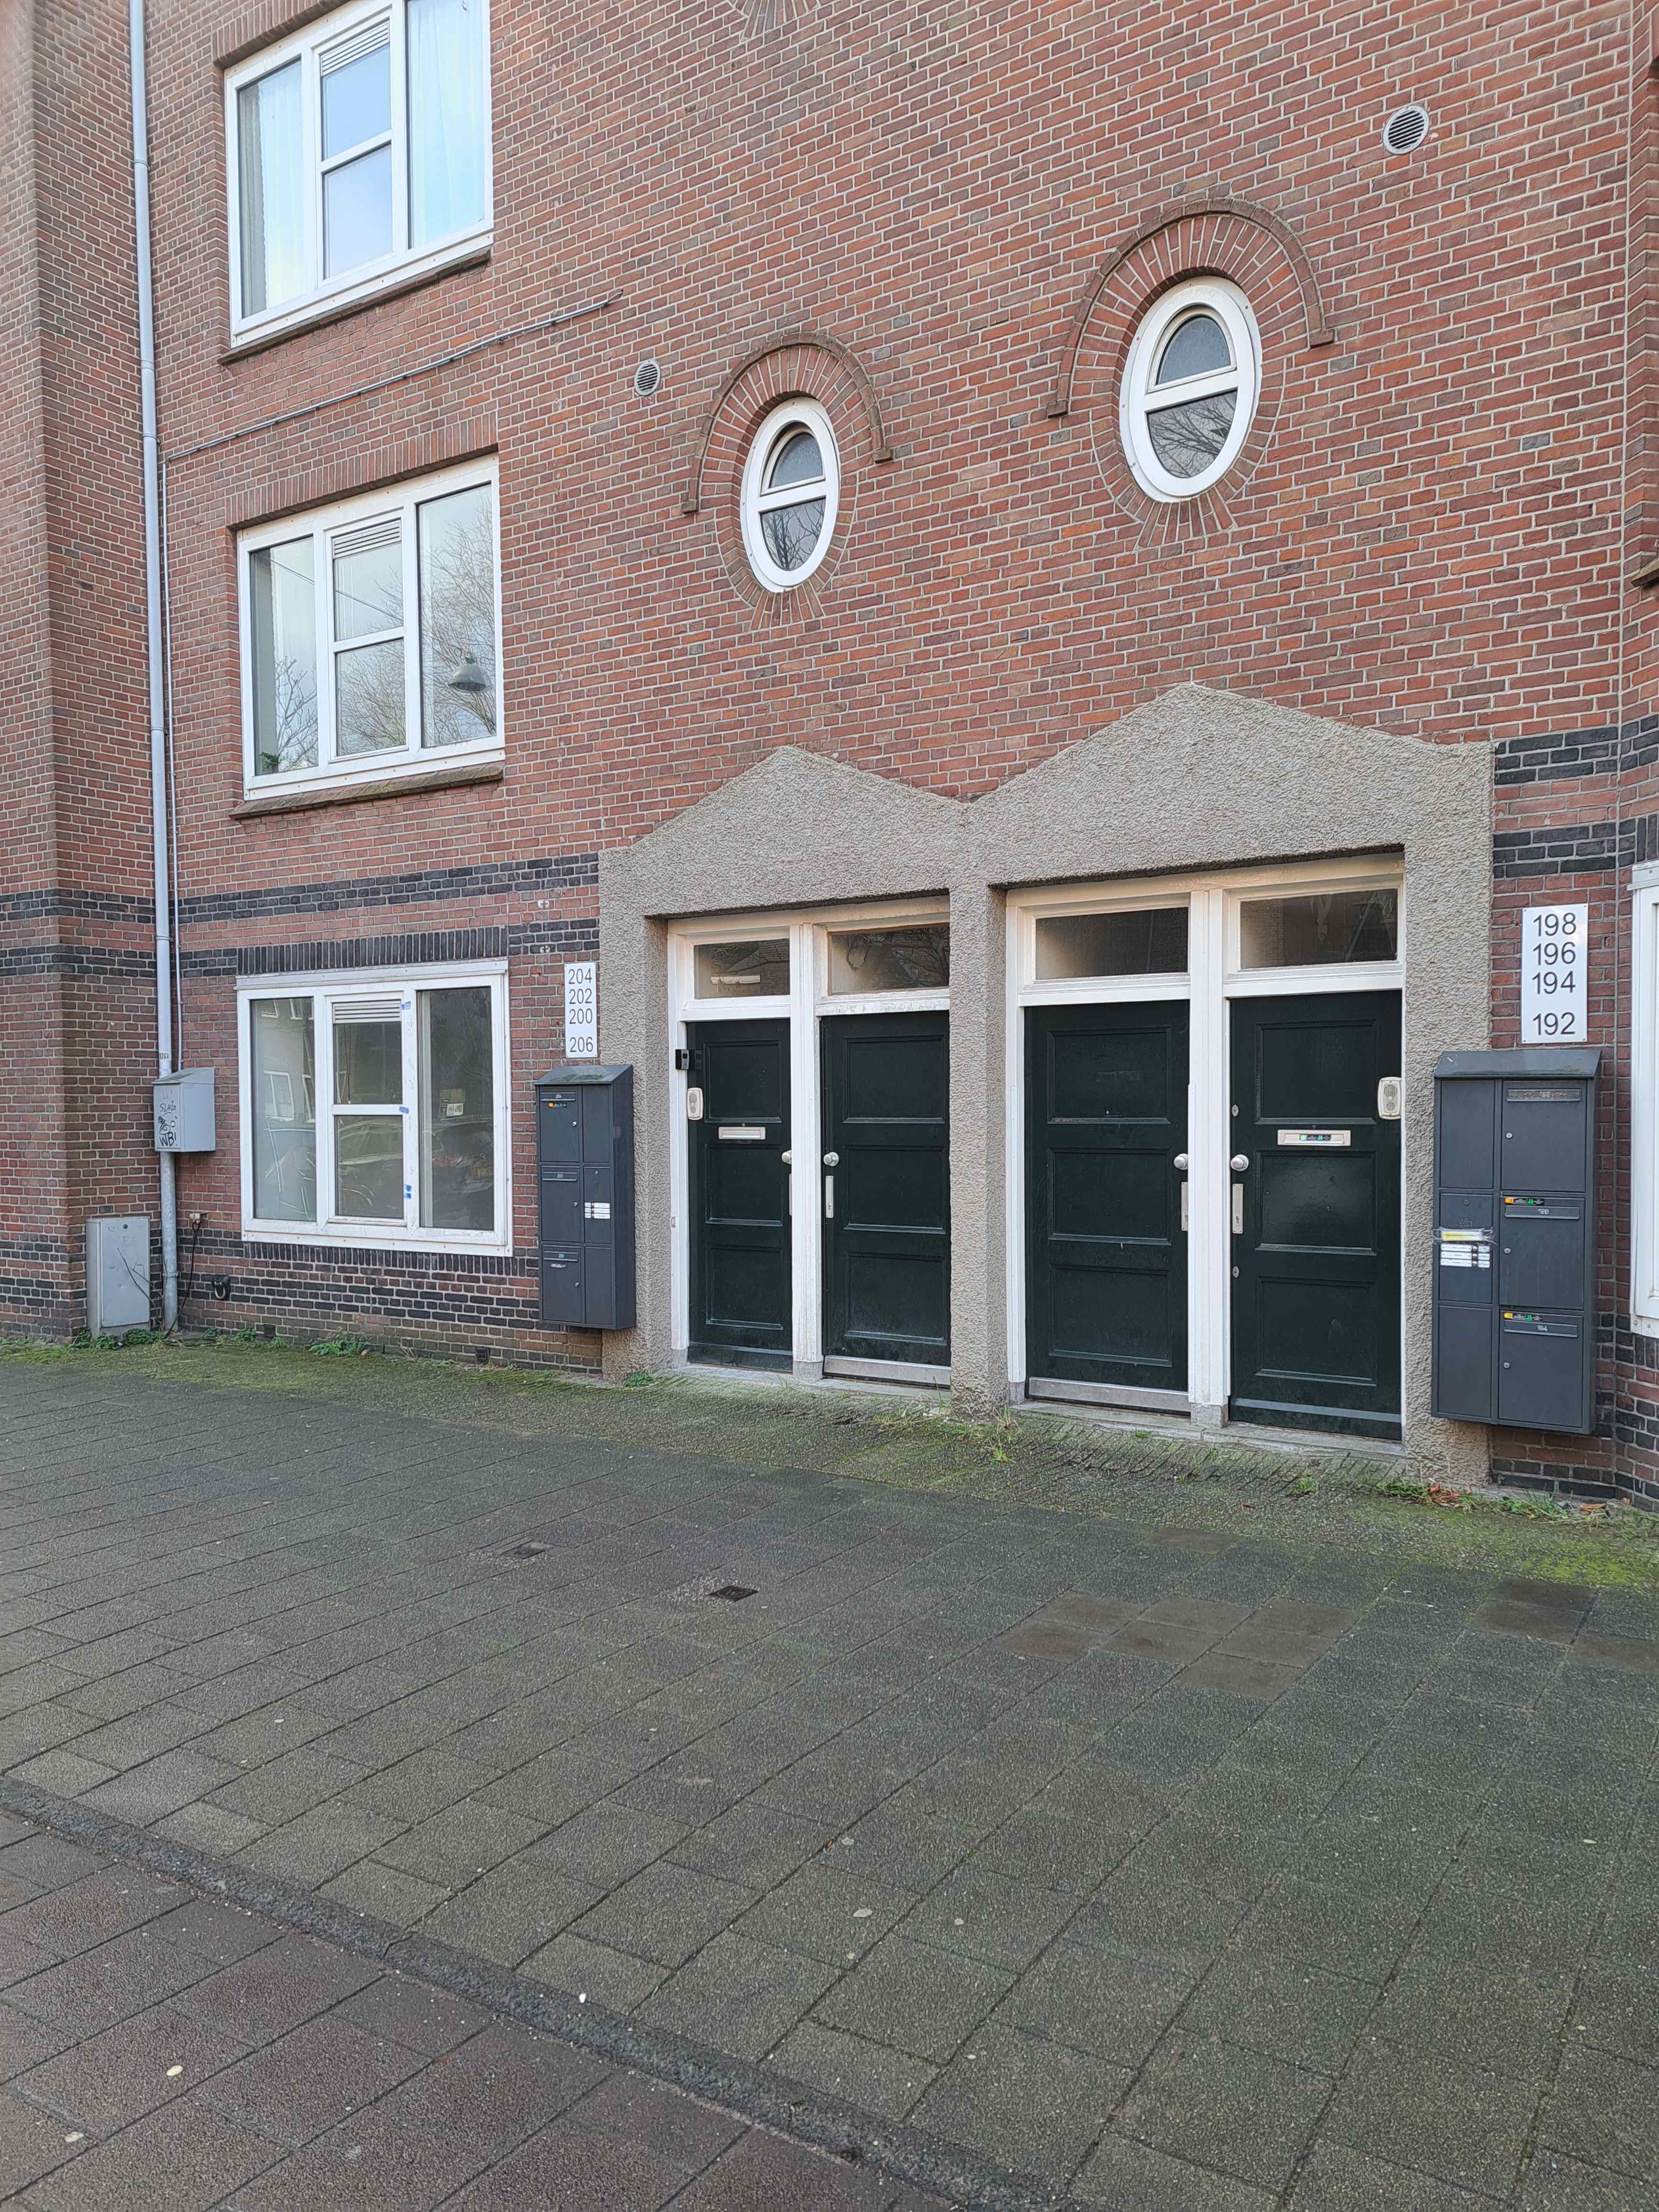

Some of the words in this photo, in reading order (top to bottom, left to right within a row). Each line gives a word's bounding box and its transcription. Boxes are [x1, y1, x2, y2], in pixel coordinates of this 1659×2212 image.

[1533, 912, 1577, 937] 198
[1533, 941, 1576, 966] 196
[568, 968, 592, 984] 204
[1532, 970, 1576, 995] 194
[569, 988, 592, 1005] 202
[569, 1008, 593, 1024] 200
[1532, 1012, 1576, 1036] 192
[569, 1036, 593, 1052] 206
